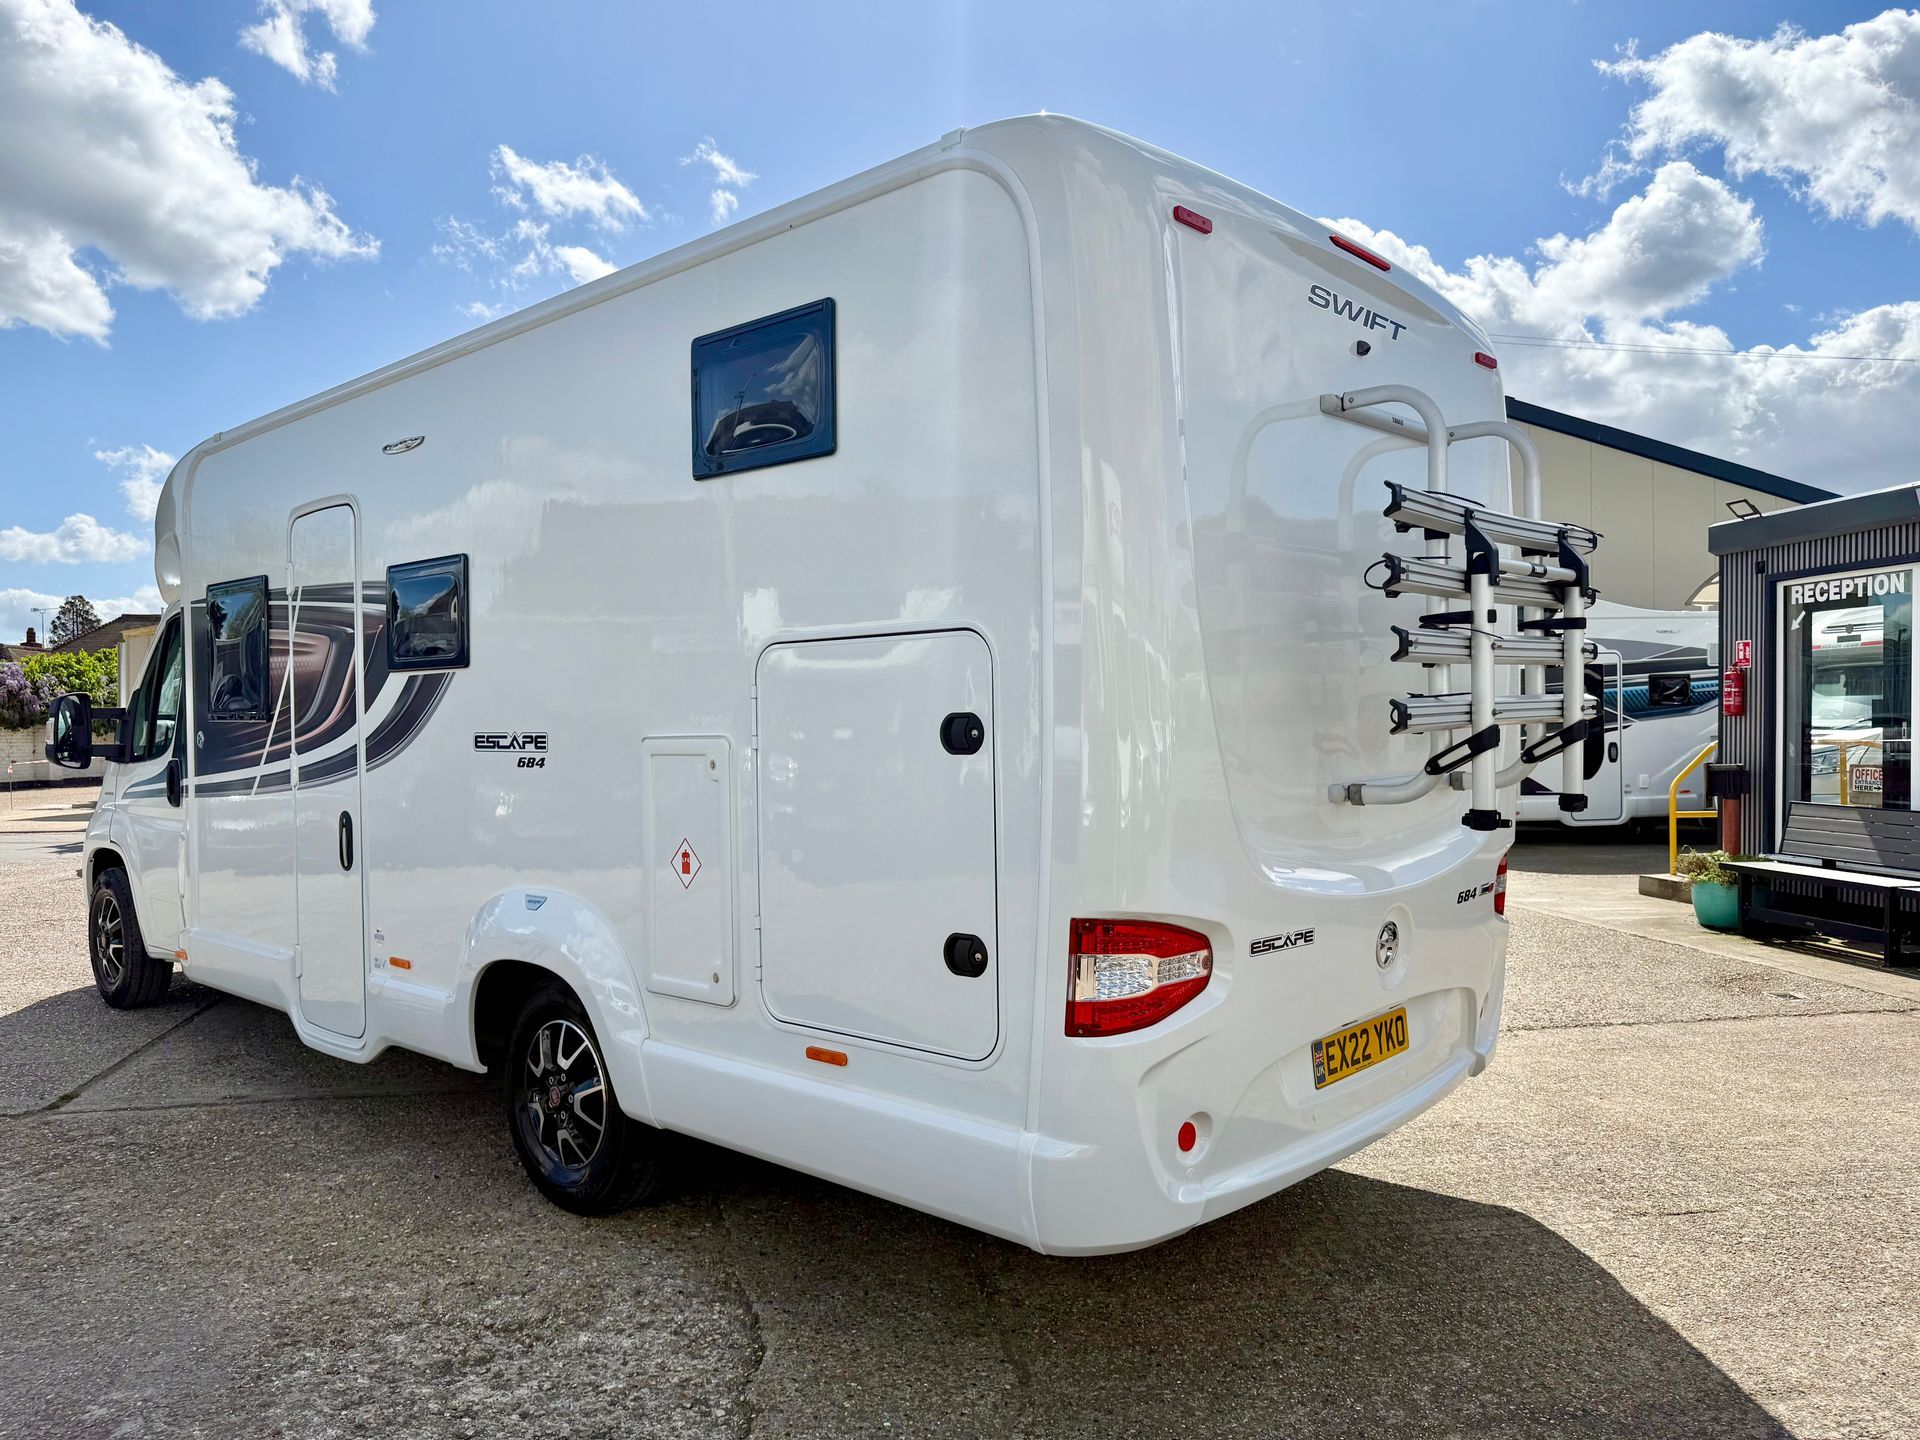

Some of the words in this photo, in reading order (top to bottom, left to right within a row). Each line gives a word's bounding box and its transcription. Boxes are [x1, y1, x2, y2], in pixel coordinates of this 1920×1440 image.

[1307, 284, 1407, 341] SWIFT
[1791, 572, 1905, 605] RECEPTION
[474, 734, 547, 750] ESCAPE
[516, 757, 546, 769] 684
[1855, 768, 1883, 781] OFFICE
[1456, 887, 1478, 904] 684
[1250, 929, 1314, 955] ESCAPE
[1325, 1027, 1372, 1076] EX22
[1373, 1014, 1406, 1055] YKO
[1315, 1065, 1326, 1077] UK
